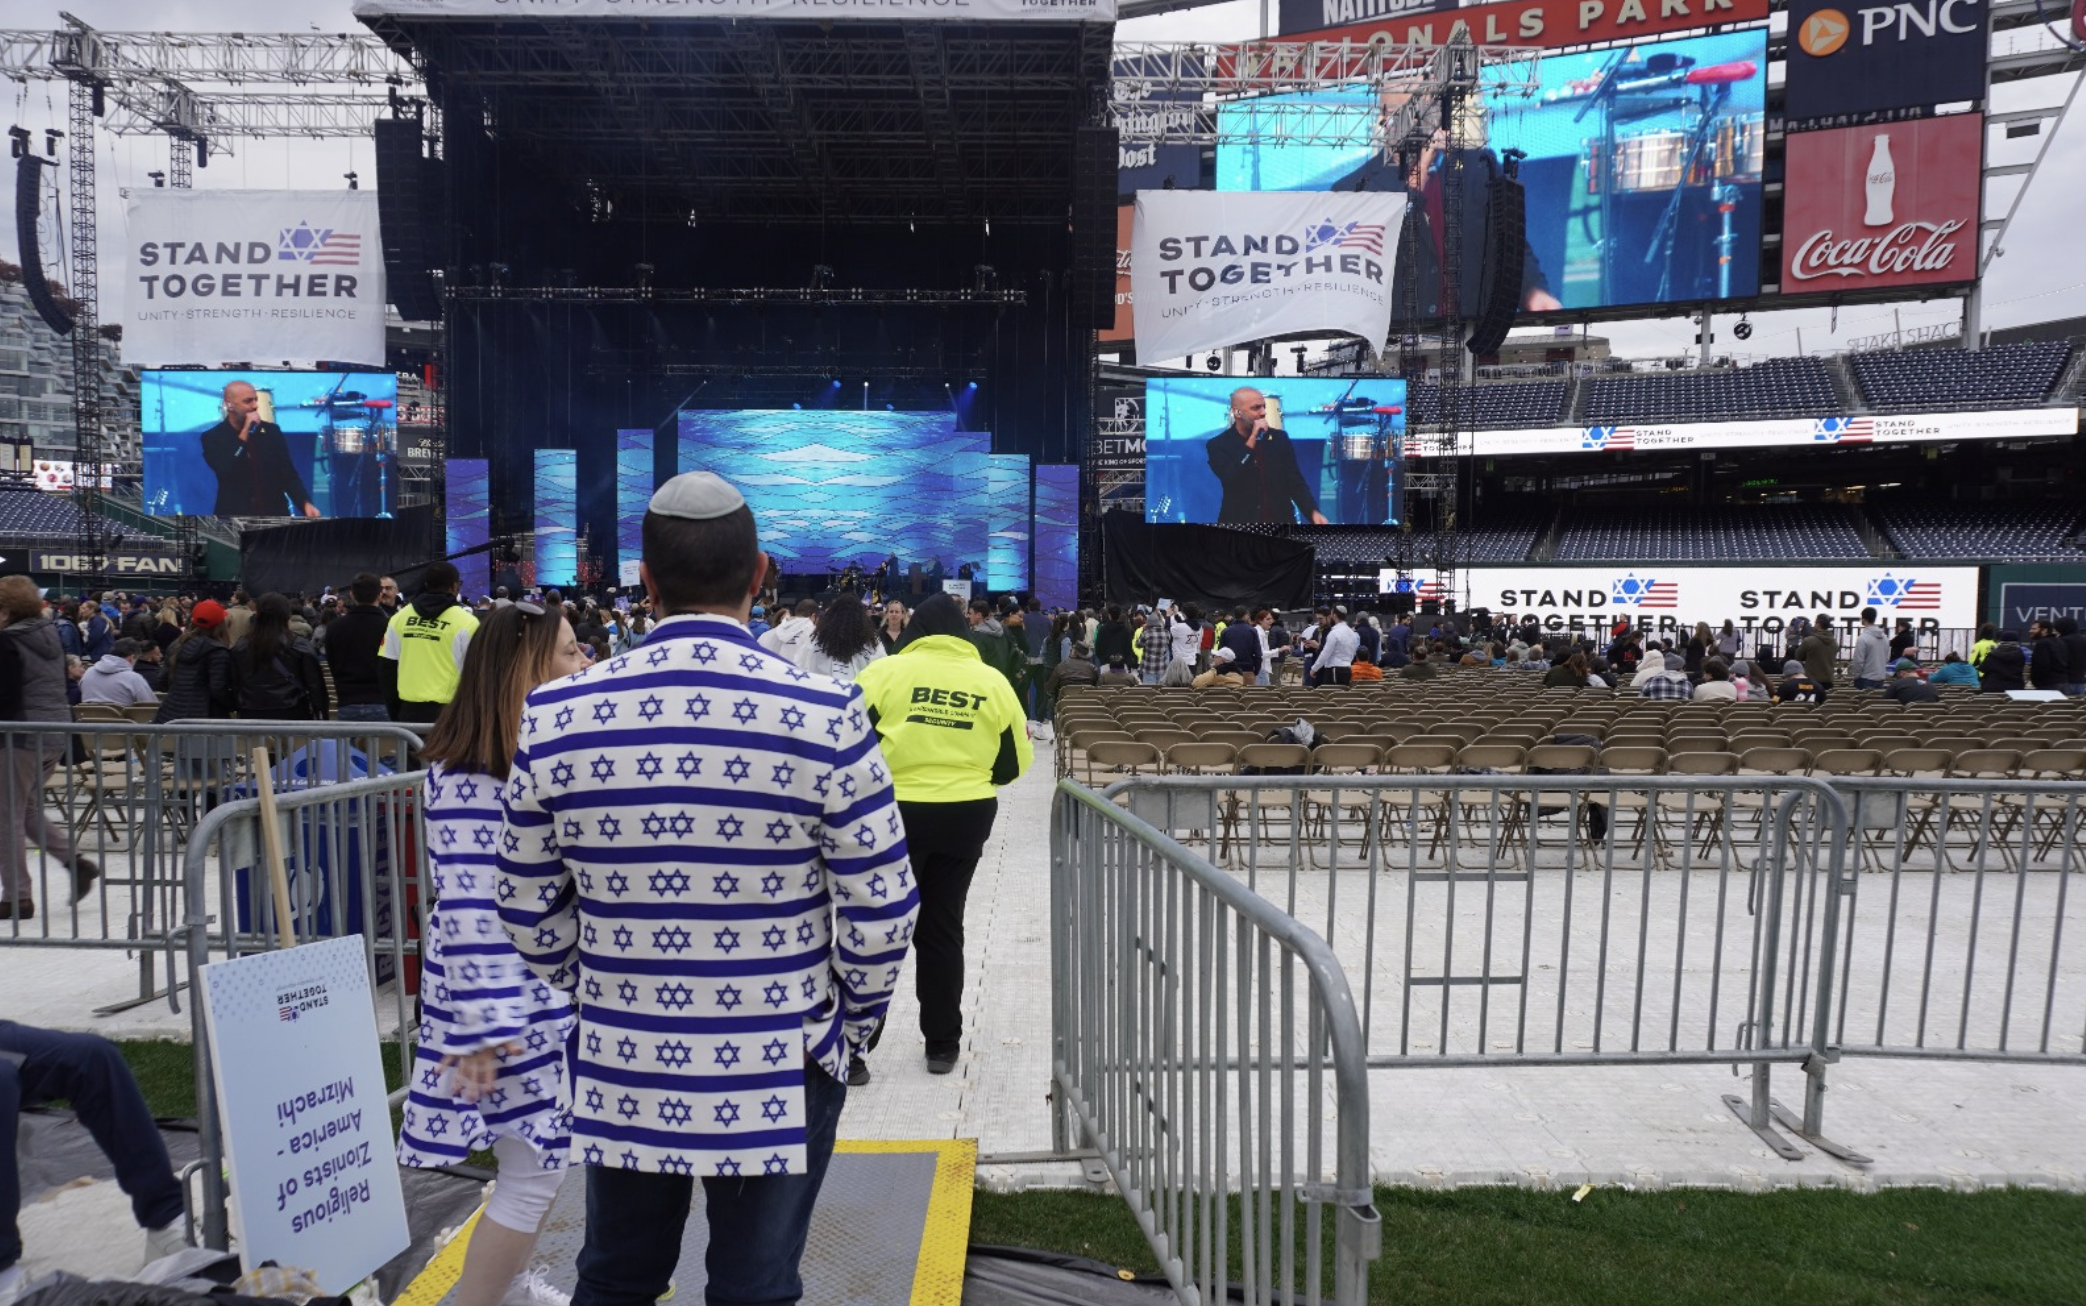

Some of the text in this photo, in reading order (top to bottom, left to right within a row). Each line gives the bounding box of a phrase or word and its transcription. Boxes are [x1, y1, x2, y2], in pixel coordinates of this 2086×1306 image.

[1858, 0, 1977, 46] PNC
[139, 241, 272, 267] STAND
[1159, 233, 1299, 261] STAND
[1791, 218, 1968, 280] Coca-Cola
[1160, 253, 1384, 294] TOGETHER
[139, 273, 358, 300] TOGETHER
[137, 308, 356, 321] UNITY STRENGTH RESILIENCE
[1636, 429, 1672, 437] STAND
[1876, 420, 1915, 428] STAND
[1876, 427, 1940, 436] TOGETHER
[1636, 437, 1694, 445] TOGETHER
[1500, 589, 1607, 608] STAND
[1740, 590, 1861, 609] STAND
[405, 615, 451, 630] BEST
[2015, 606, 2086, 623] VENT
[910, 687, 988, 711] BEST
[374, 832, 396, 977] RCYCLE
[276, 983, 328, 1006] TOGETHER
[299, 995, 329, 1013] STAND
[276, 1076, 355, 1128] Mizrachi
[290, 1108, 363, 1156] America
[277, 1141, 372, 1212] Zionists of
[292, 1178, 371, 1234] Religious
